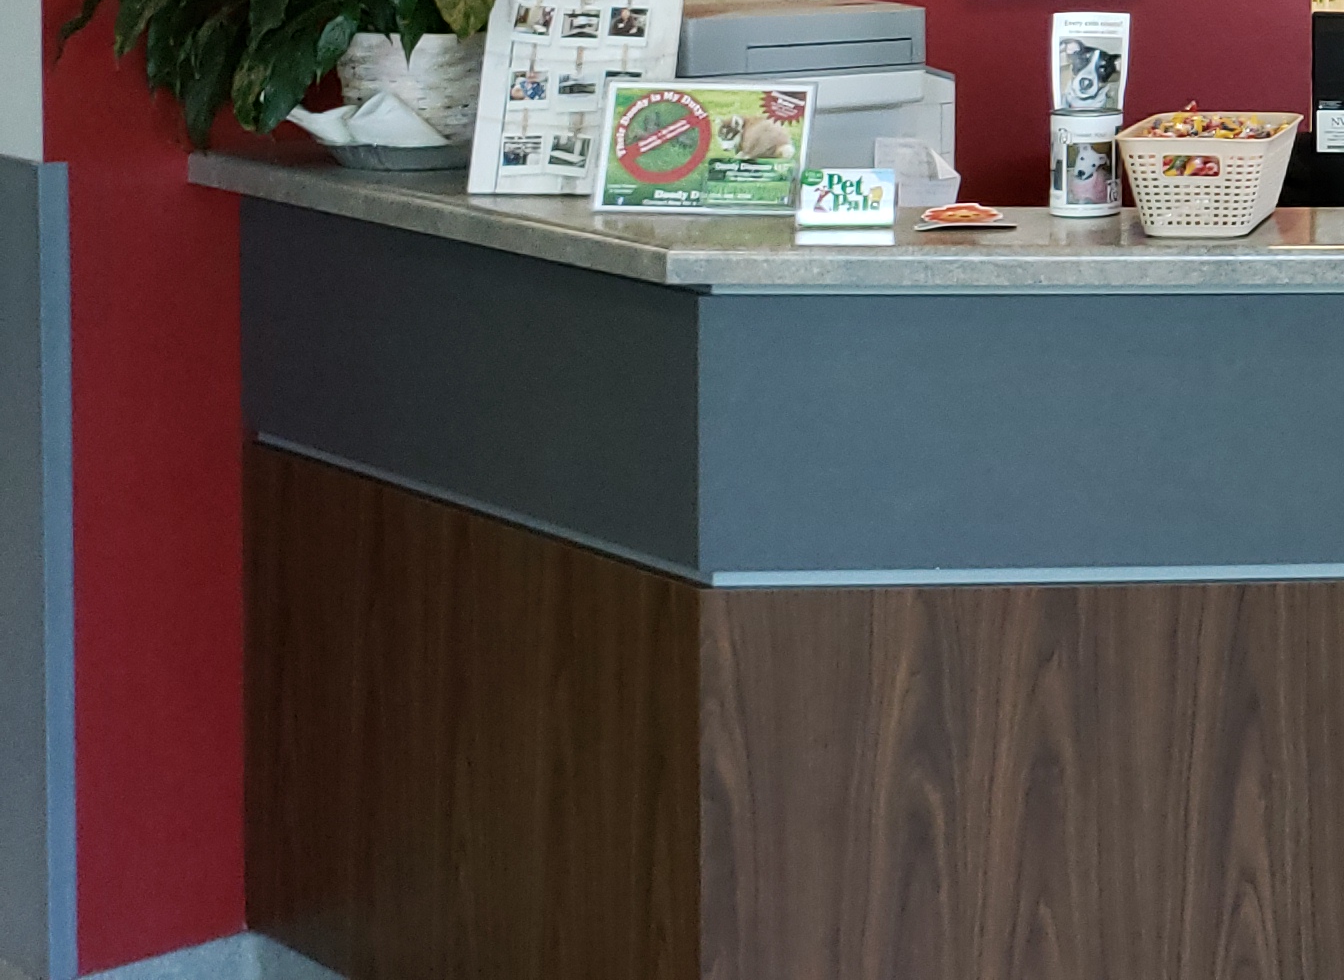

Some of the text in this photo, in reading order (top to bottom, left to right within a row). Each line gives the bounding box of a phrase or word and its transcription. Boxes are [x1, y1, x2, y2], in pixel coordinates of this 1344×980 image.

[663, 91, 681, 103] My
[681, 94, 708, 120] Duty!
[827, 173, 864, 195] Pet
